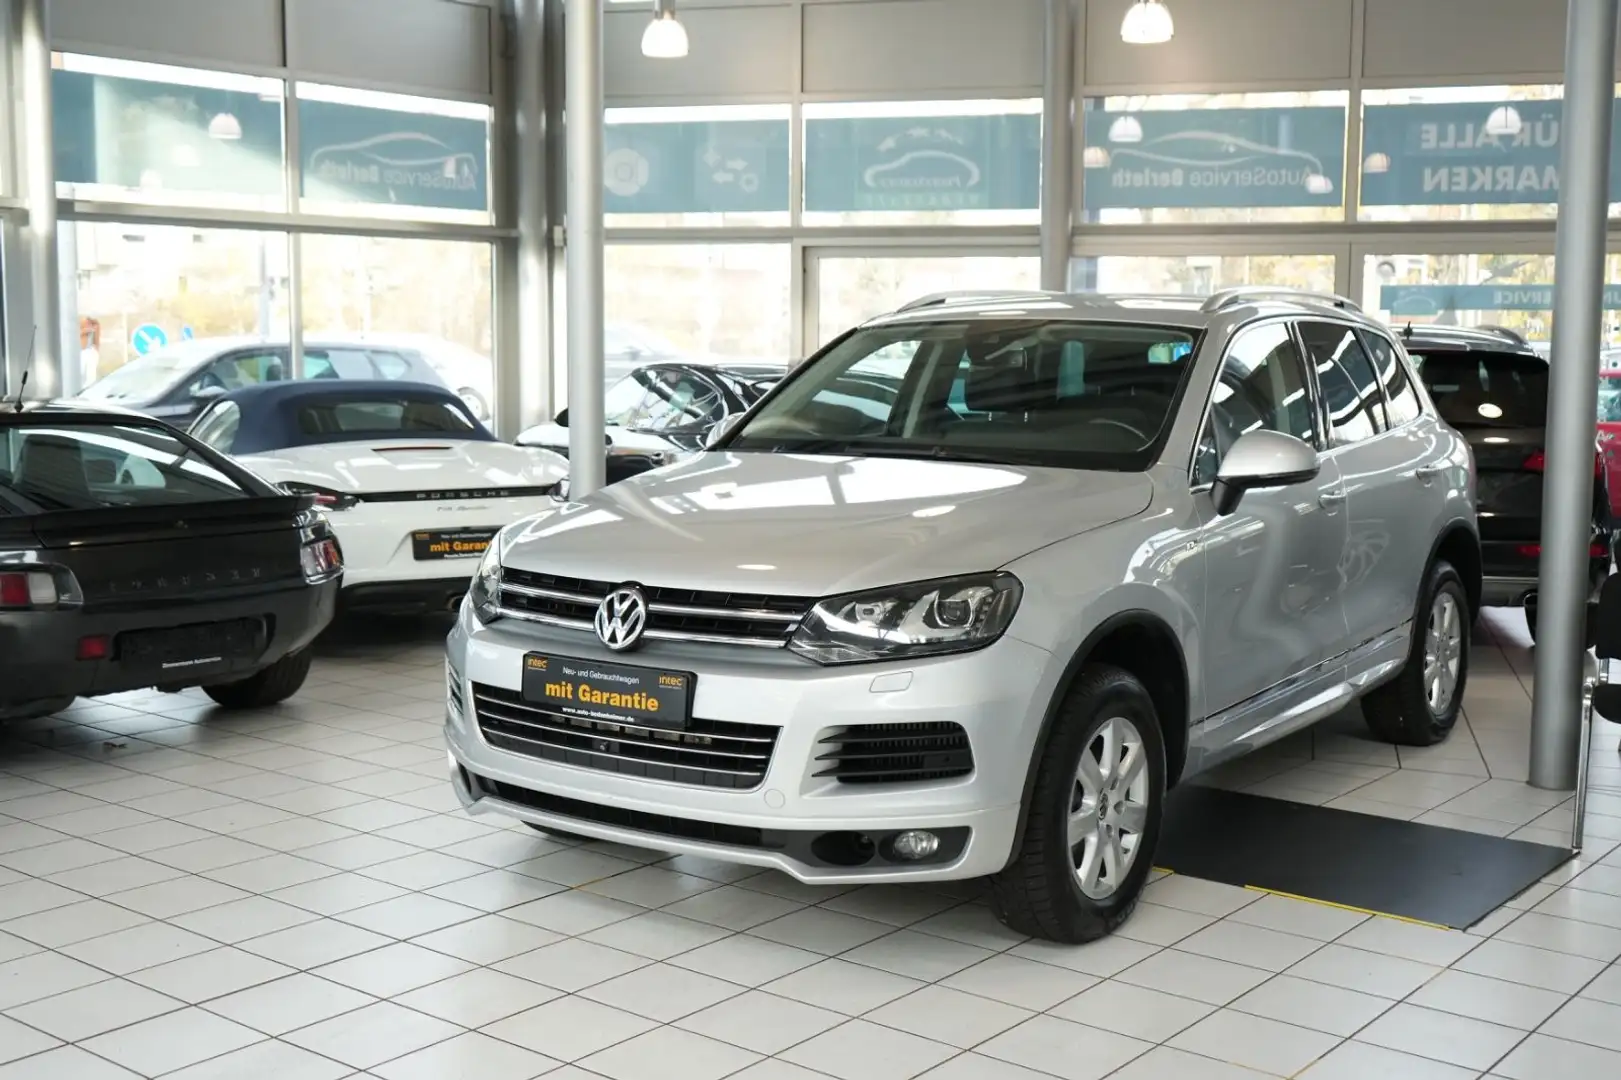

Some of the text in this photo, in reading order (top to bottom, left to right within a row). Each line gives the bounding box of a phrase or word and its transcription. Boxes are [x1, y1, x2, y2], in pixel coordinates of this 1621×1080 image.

[430, 541, 450, 552] mit
[562, 666, 640, 685] Neu- und Gebrauchtwagen
[658, 675, 683, 687] intec
[545, 681, 659, 711] mit Garantie
